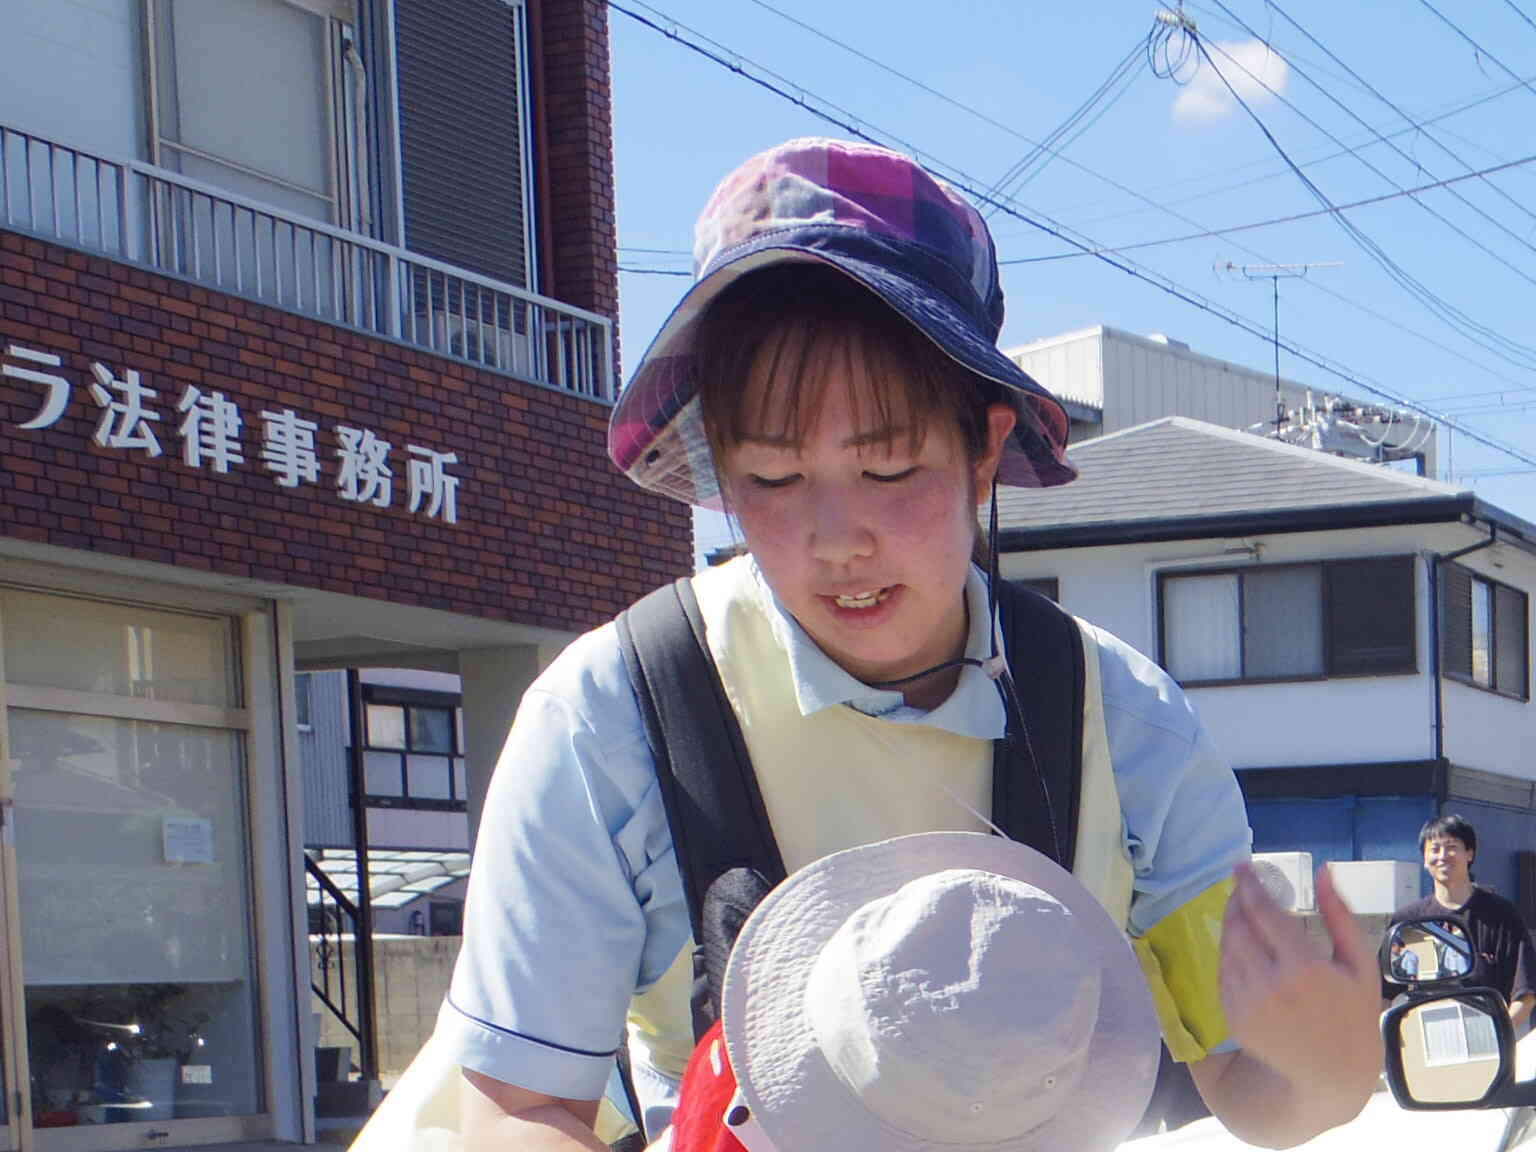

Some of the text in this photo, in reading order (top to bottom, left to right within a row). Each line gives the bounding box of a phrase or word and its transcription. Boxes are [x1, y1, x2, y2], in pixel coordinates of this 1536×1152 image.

[2, 345, 459, 524] ラ法律事務所
